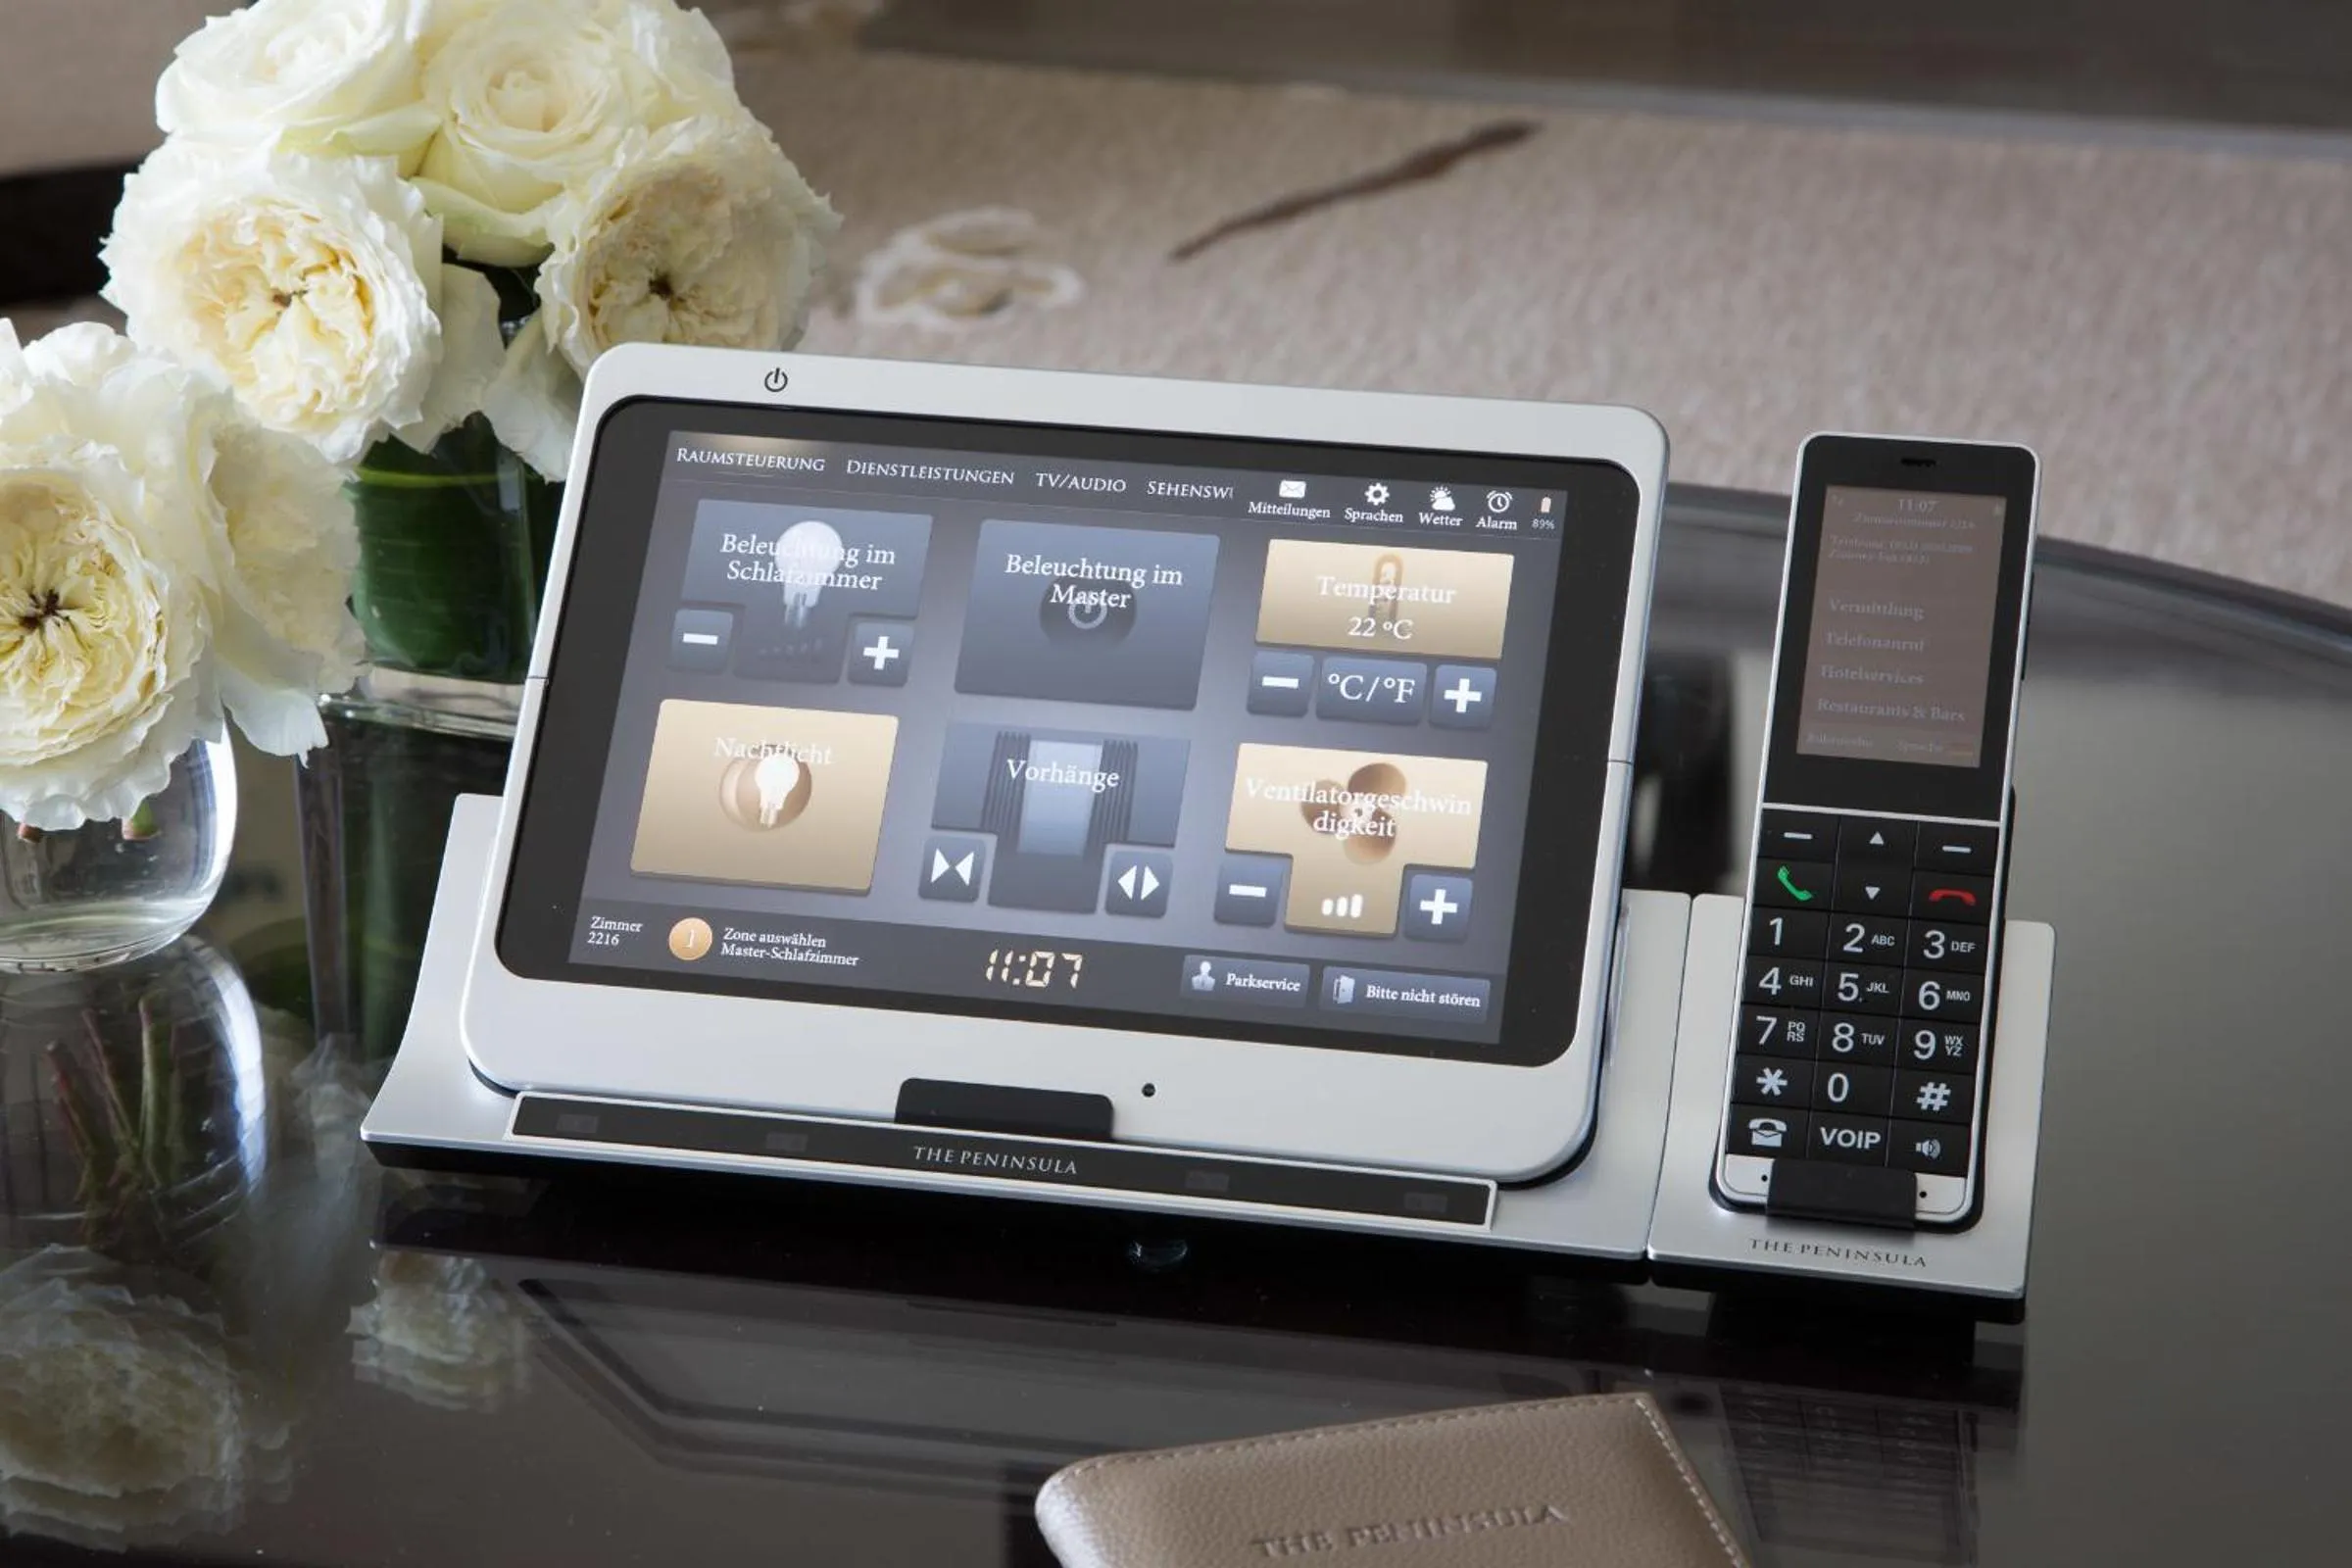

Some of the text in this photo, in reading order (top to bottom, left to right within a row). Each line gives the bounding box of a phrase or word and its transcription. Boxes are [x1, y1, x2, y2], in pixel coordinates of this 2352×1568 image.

[676, 447, 825, 472] RAUMSTEUERUNG
[846, 459, 1014, 486] DIENSTLEISTUNGEN
[1035, 471, 1126, 494] TV/AUDIO
[1248, 502, 1518, 530] Mitteilungen Sprachen Wetter Alarm
[1531, 518, 1555, 530] 89%
[866, 544, 896, 565] im
[1004, 553, 1183, 587] Beleuchtung im
[1052, 584, 1131, 609] Master
[1317, 575, 1456, 605] Temperatur
[1348, 616, 1376, 638] 22
[1007, 759, 1120, 793] Vorhänge
[1246, 777, 1472, 815] Ventilatorgeschwin
[1313, 810, 1396, 841] digkeit
[591, 915, 643, 932] Zimmer
[723, 927, 826, 948] Zone auswählen
[1769, 916, 1784, 946] 1
[1843, 923, 1895, 953] 2 ABC
[588, 932, 620, 946] 2216
[1923, 930, 1976, 959] 3 DEF
[721, 943, 859, 966] Master-Schlafzimmer
[985, 949, 1083, 989] 11:07
[1226, 972, 1300, 993] Parkservice
[1366, 984, 1481, 1007] Bitte nicht stören
[1758, 966, 1813, 996] 4 GHI
[1838, 972, 1889, 1002] 5 JKL
[1918, 981, 1971, 1010] 6 MNO
[1756, 1015, 1805, 1045] 7 PQ
[1787, 1032, 1805, 1042] RS
[1832, 1022, 1886, 1053] 8 TUV
[1913, 1030, 1963, 1059] 9 WX
[1944, 1046, 1963, 1056] YZ
[1828, 1072, 1849, 1102] 0
[1820, 1126, 1882, 1150] VOIP
[913, 1146, 1078, 1175] THE PENINSULA
[1749, 1238, 1928, 1267] THE PENINSULA
[1250, 1504, 1570, 1557] THE PENINSULA
